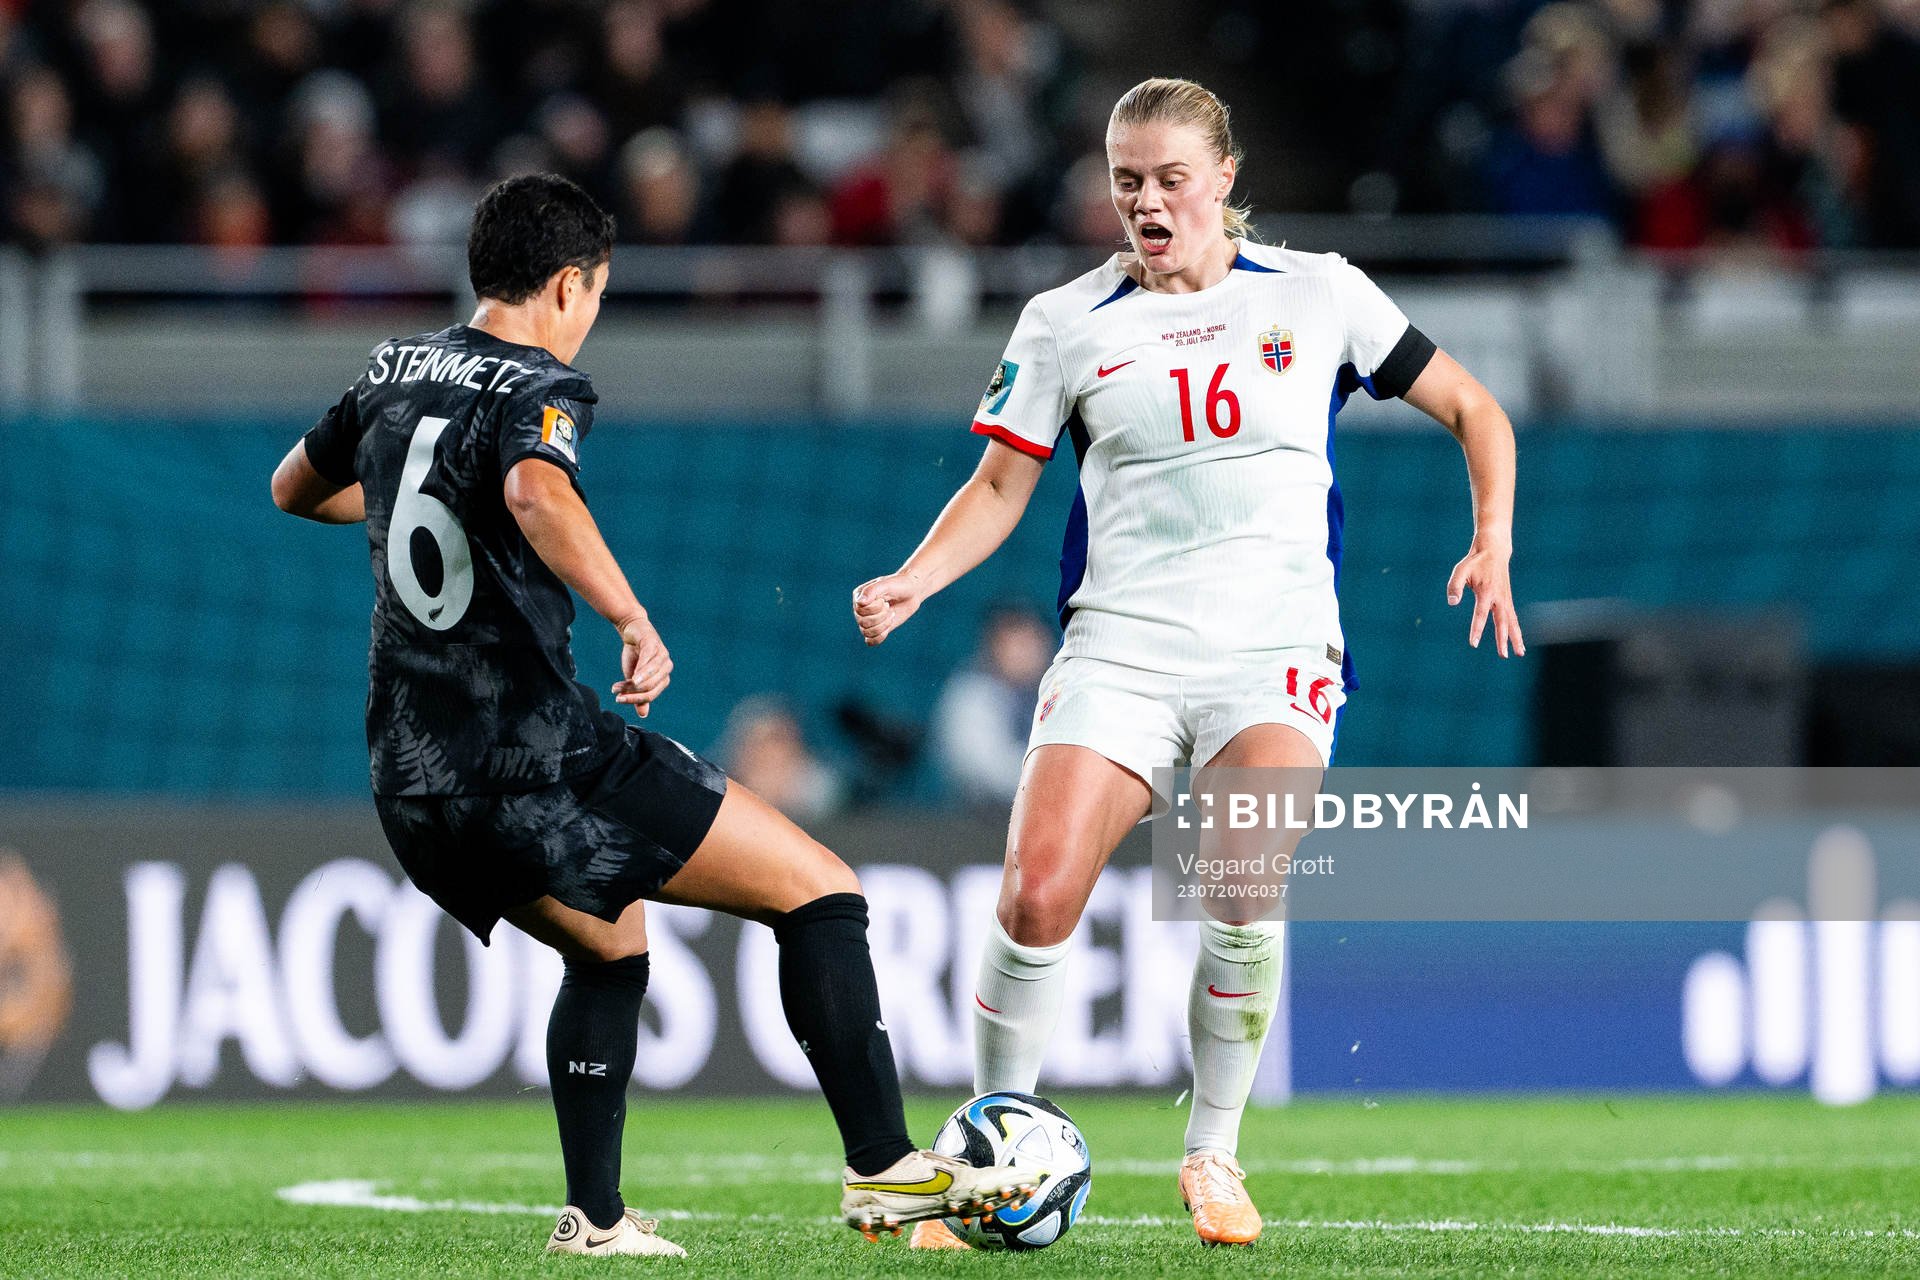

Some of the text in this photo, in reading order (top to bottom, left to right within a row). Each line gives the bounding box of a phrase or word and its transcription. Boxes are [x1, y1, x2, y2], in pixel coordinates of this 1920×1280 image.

[1161, 333, 1175, 341] NEW
[1176, 328, 1202, 339] ZEALAND
[1206, 323, 1227, 334] NORGE
[1186, 336, 1199, 346] JULI
[1199, 333, 1215, 343] 2023
[368, 345, 537, 394] STEINMETZ
[1169, 363, 1241, 443] 16
[387, 415, 475, 631] 6
[1285, 666, 1336, 725] 16
[87, 856, 719, 1111] JACOS
[568, 1060, 607, 1077] NZ
